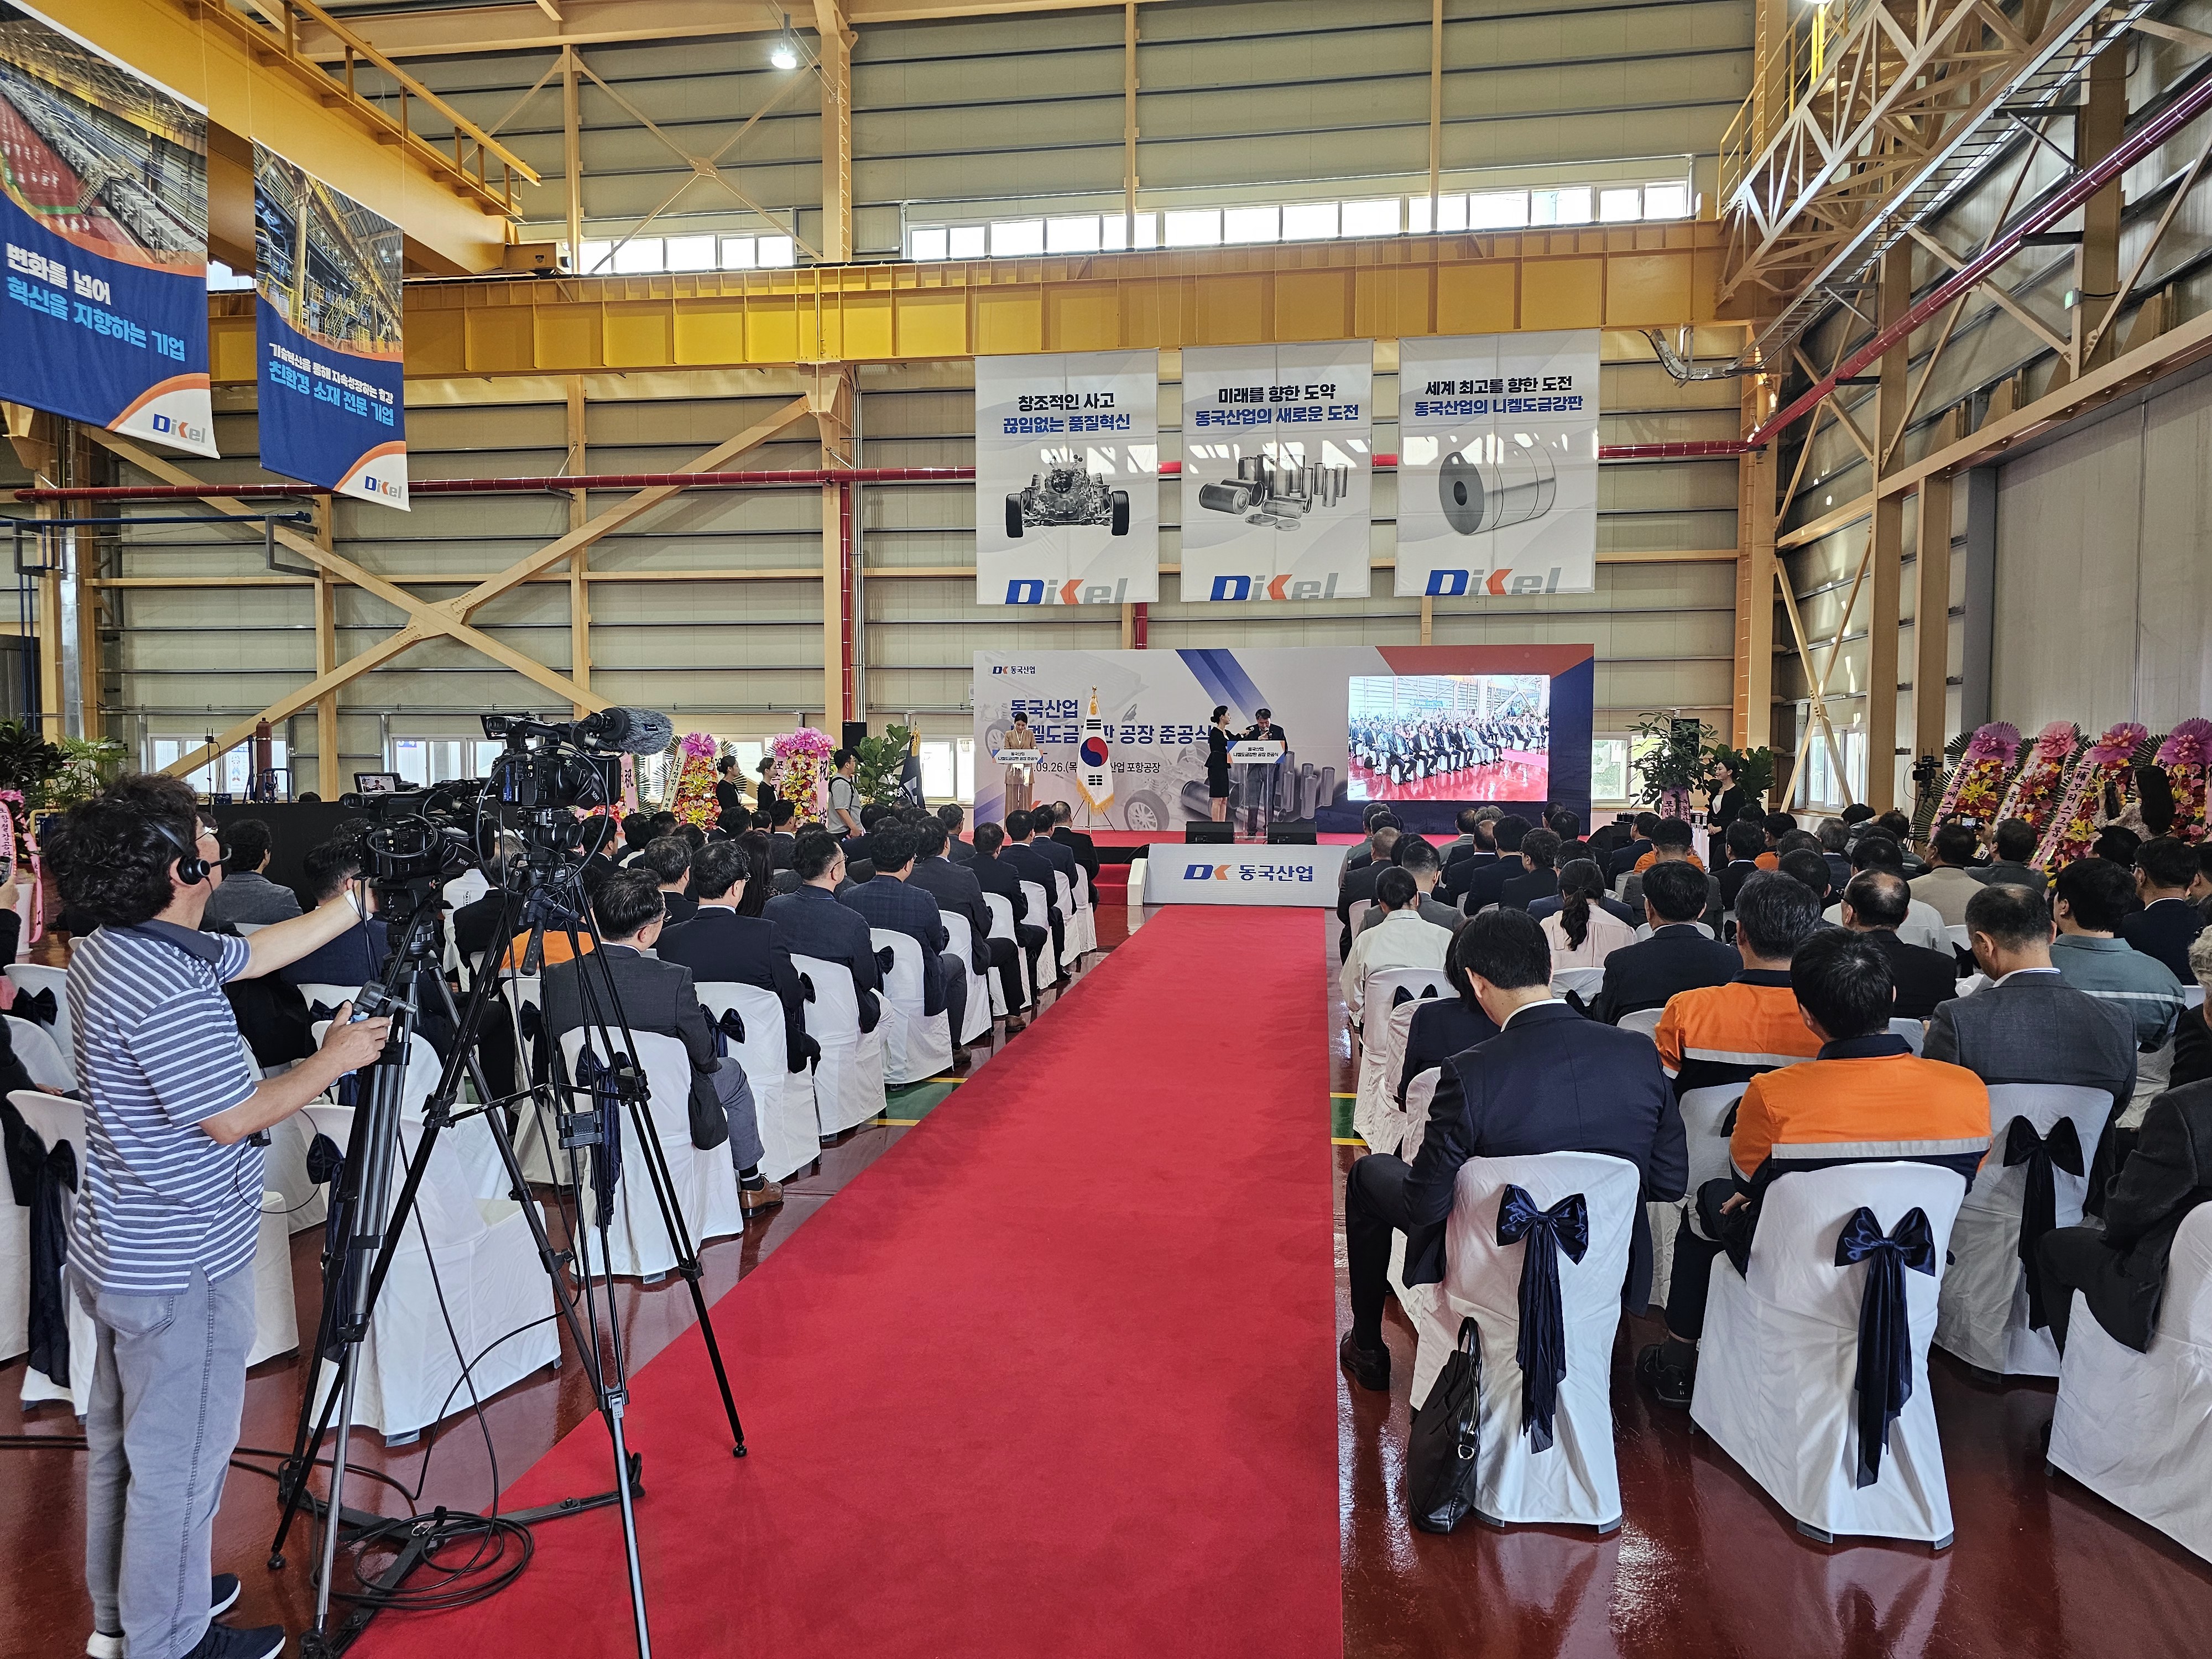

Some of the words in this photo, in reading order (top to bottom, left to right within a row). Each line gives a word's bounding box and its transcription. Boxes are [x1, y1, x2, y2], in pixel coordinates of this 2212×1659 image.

[7, 243, 67, 289] 변화를
[74, 270, 111, 305] 넘어
[7, 276, 67, 321] 혁신을
[73, 301, 147, 348] 지향하는
[152, 331, 185, 362] 기업
[269, 343, 311, 373] 기술혁신을
[313, 362, 331, 380] 통해
[332, 369, 377, 398] 지속성장하는
[269, 361, 310, 394] 친환경
[314, 381, 340, 406] 소재
[343, 391, 368, 416] 전문
[371, 401, 394, 426] 기업
[1218, 387, 1265, 404] 미래를
[1269, 385, 1300, 402] 향한
[1303, 384, 1336, 400] 도약
[1425, 380, 1455, 396] 세계
[1459, 378, 1504, 395] 최고를
[1507, 377, 1538, 393] 향한
[1542, 376, 1573, 392] 도전
[1018, 394, 1079, 411] 창조적인
[1083, 393, 1115, 409] 사고
[1414, 399, 1488, 417] 동국산업의
[1493, 395, 1583, 414] 니켈도금강판
[1003, 417, 1065, 434] 끊임없는
[1069, 414, 1130, 432] 품질혁신
[1195, 408, 1272, 426] 동국산업의
[1276, 406, 1323, 423] 새로운
[1328, 404, 1359, 421] 도전
[1011, 666, 1035, 674] 동국산업
[1011, 700, 1078, 718] 동국산업
[1120, 725, 1154, 744] 공장
[1160, 725, 1210, 744] 준공식
[1126, 763, 1161, 773] 포항공장
[591, 790, 600, 801] SONY
[457, 858, 469, 867] SONY
[1183, 864, 1232, 880] DK
[1239, 864, 1313, 882] 동국산업
